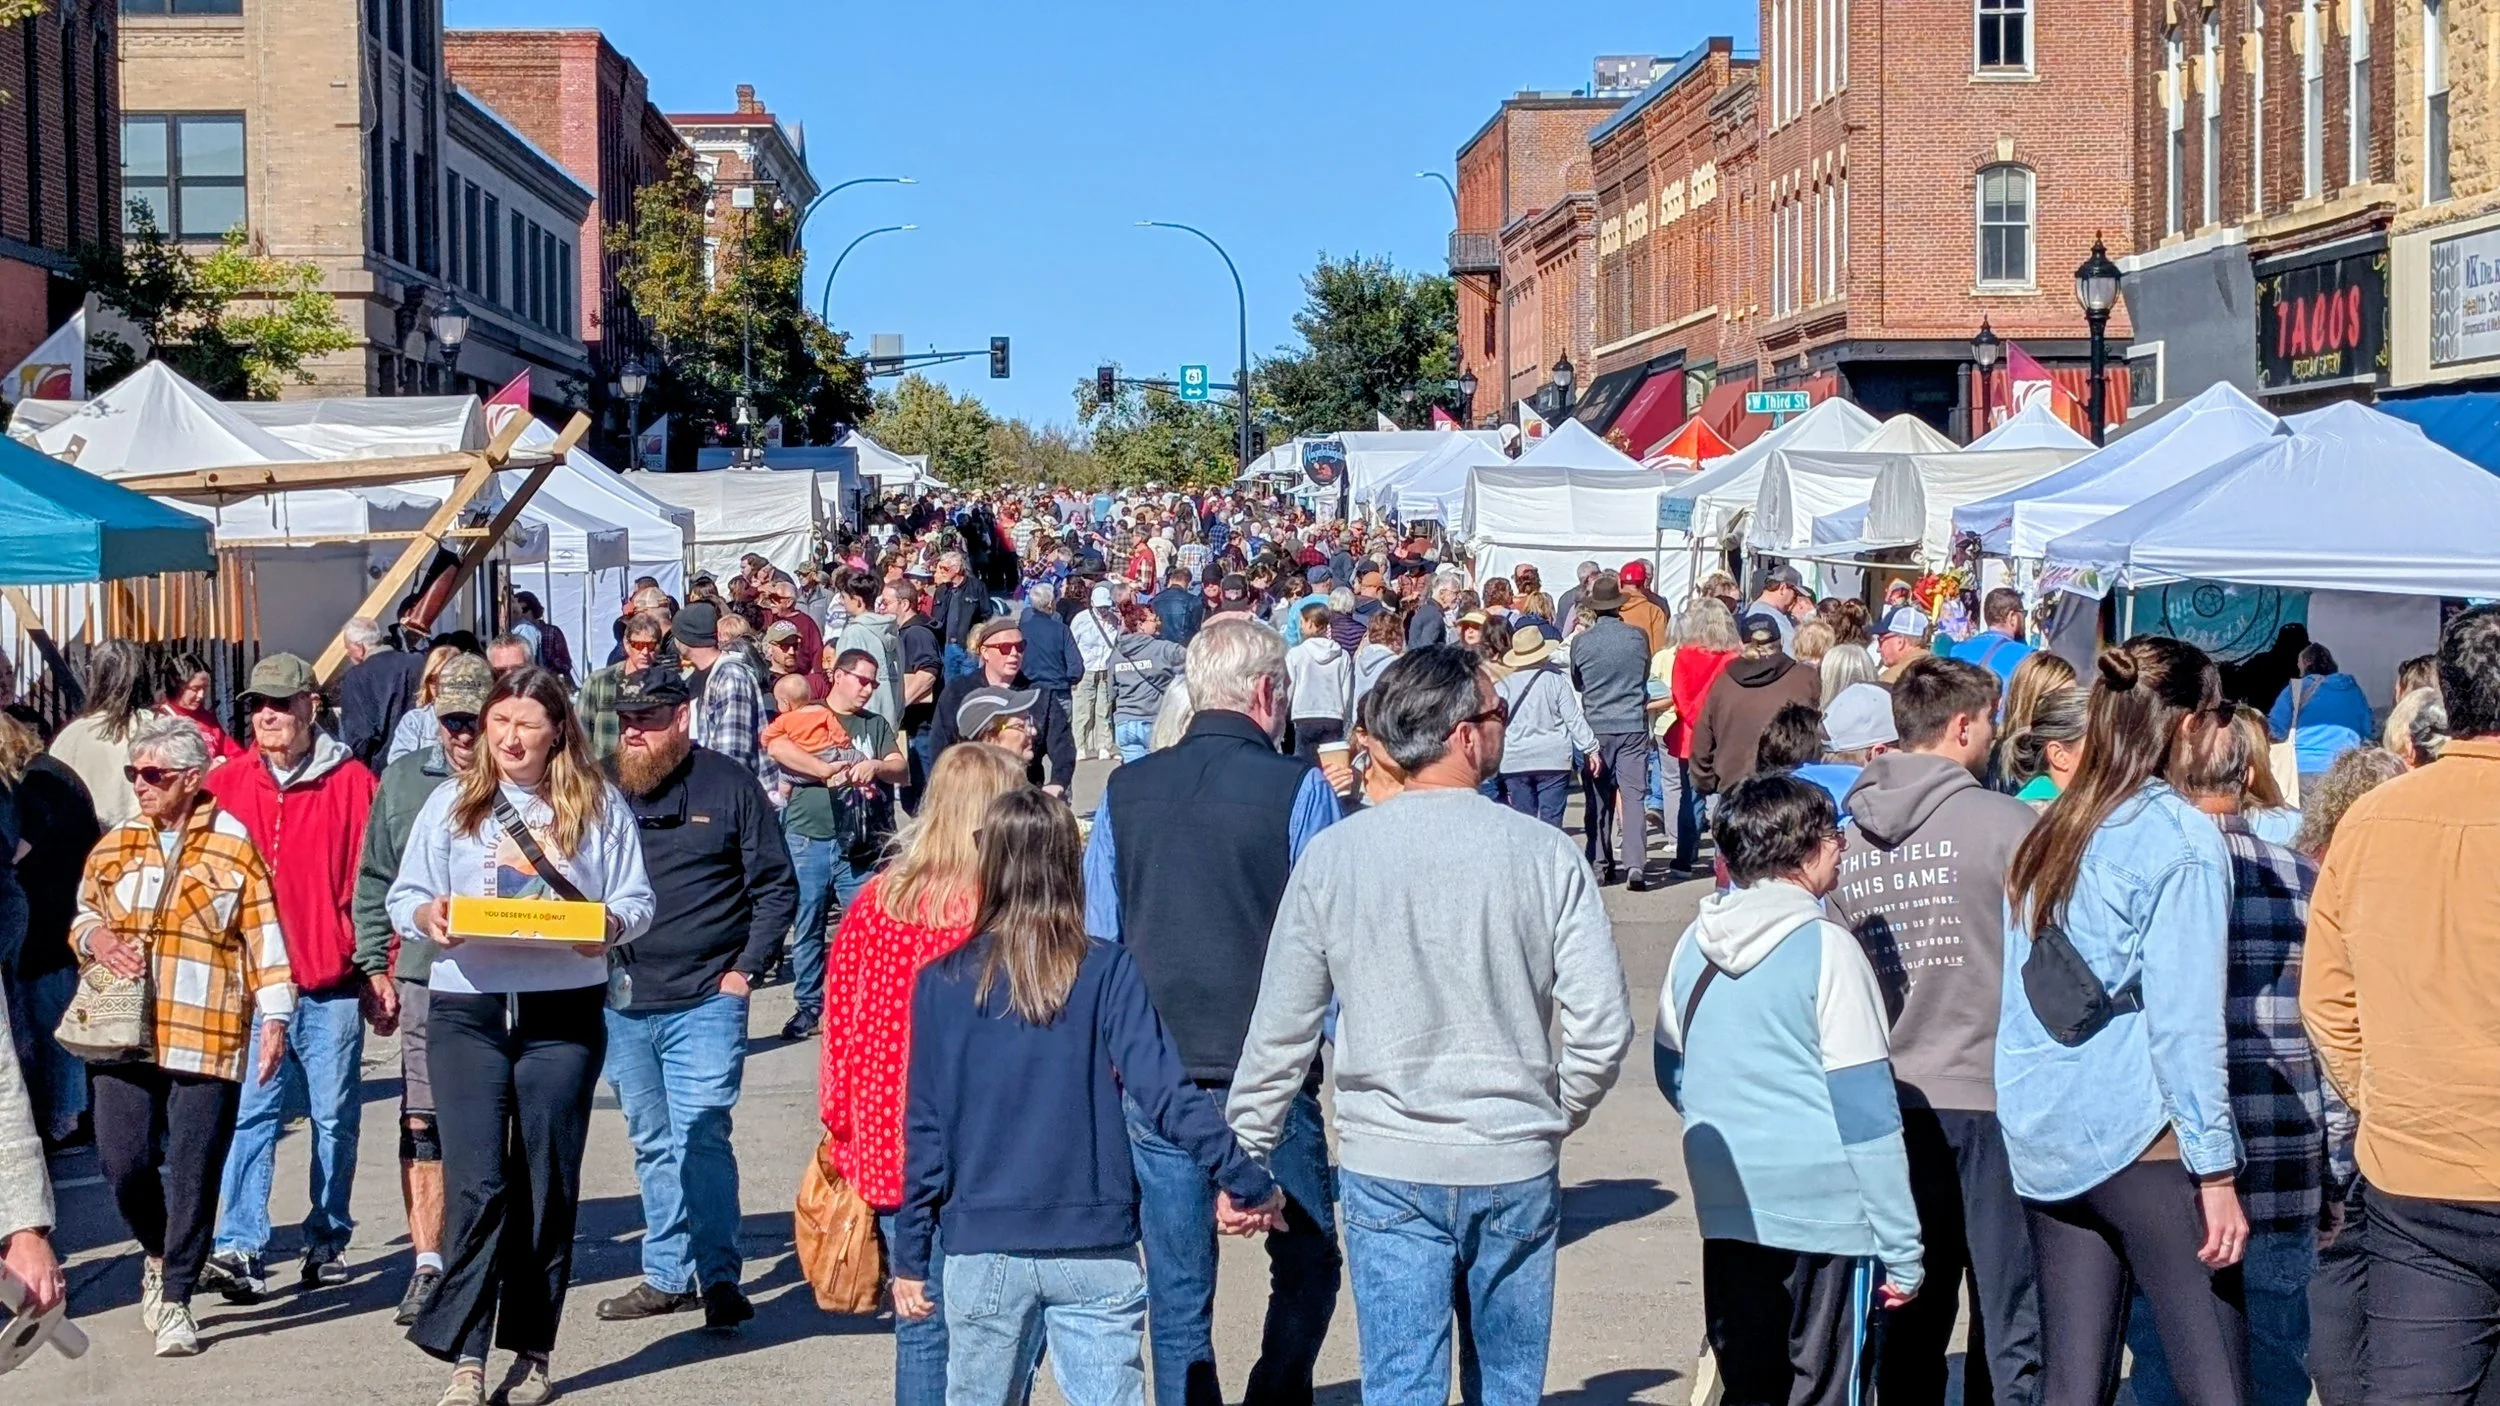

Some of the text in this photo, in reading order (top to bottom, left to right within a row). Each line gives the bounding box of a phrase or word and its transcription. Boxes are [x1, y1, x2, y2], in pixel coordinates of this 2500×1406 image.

[2276, 284, 2361, 358] TACOS
[1189, 371, 1200, 382] 61
[1751, 394, 1805, 409] W Third St
[1842, 840, 1959, 876] THIS FIELD,
[483, 877, 496, 897] HE
[1842, 867, 1957, 902] THIS GAME:
[484, 910, 499, 918] YOU
[500, 911, 532, 920] DESERVE
[539, 912, 566, 921] DONUT
[1940, 915, 1962, 926] ALL
